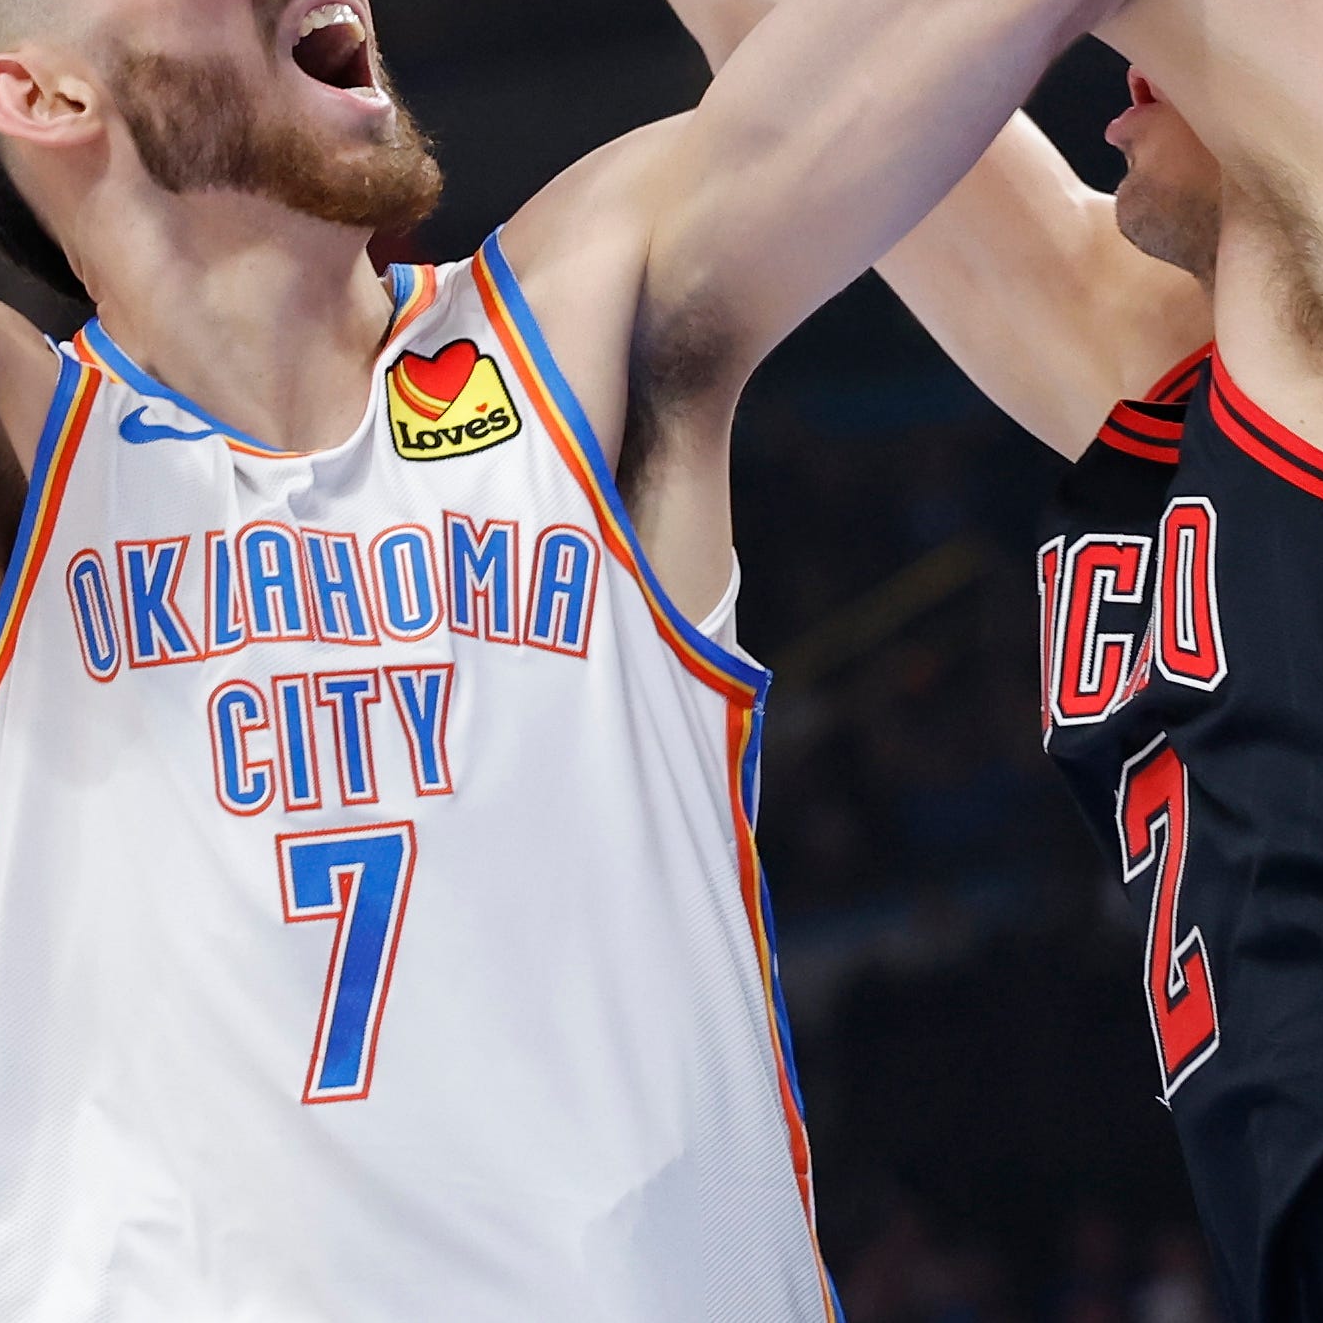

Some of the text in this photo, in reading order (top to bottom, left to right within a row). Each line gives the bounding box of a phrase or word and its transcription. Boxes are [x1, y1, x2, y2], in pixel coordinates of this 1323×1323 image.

[66, 509, 602, 683] OKLAHOMA
[208, 662, 456, 815] CITY
[276, 820, 418, 1105] 7
[1116, 730, 1221, 1102] 2
